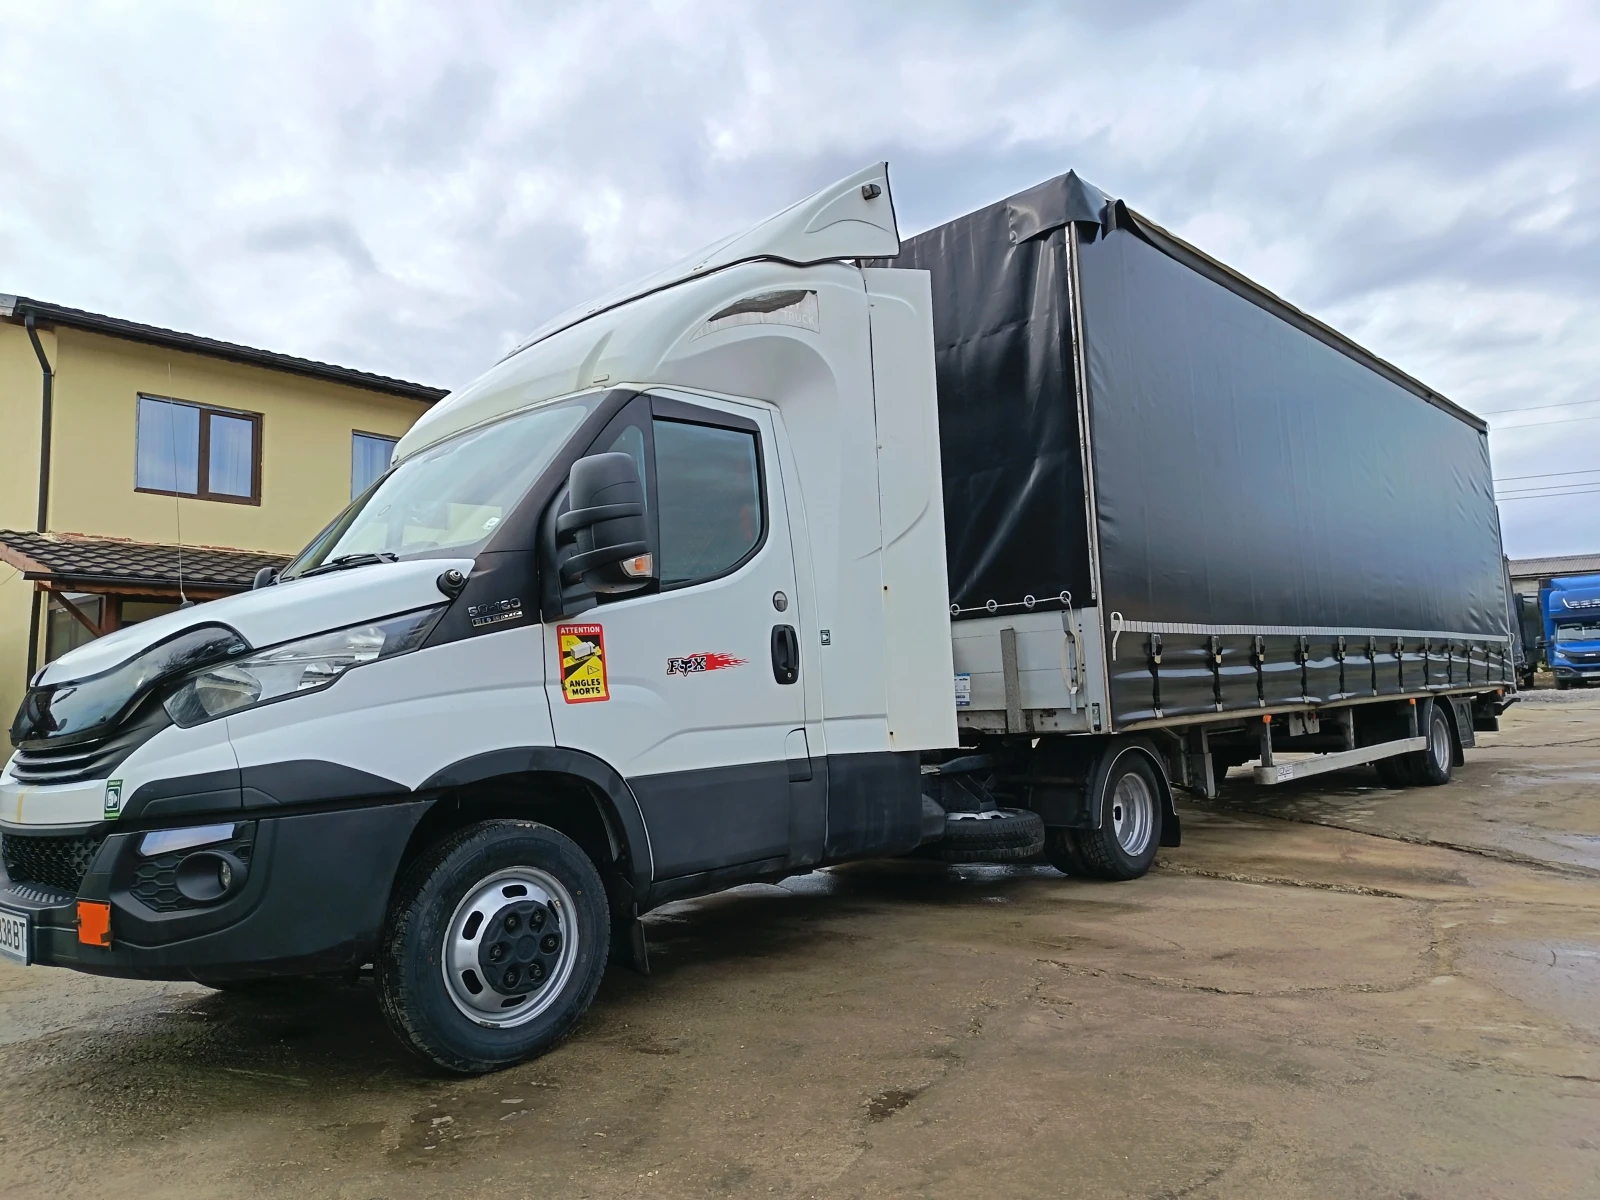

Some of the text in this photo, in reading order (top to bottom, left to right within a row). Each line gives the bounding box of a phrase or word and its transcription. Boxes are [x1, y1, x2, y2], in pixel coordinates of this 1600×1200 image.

[783, 310, 815, 325] TRUCK
[560, 626, 600, 634] ATTENTION
[569, 678, 601, 688] ANGLES
[571, 687, 601, 696] MORTS
